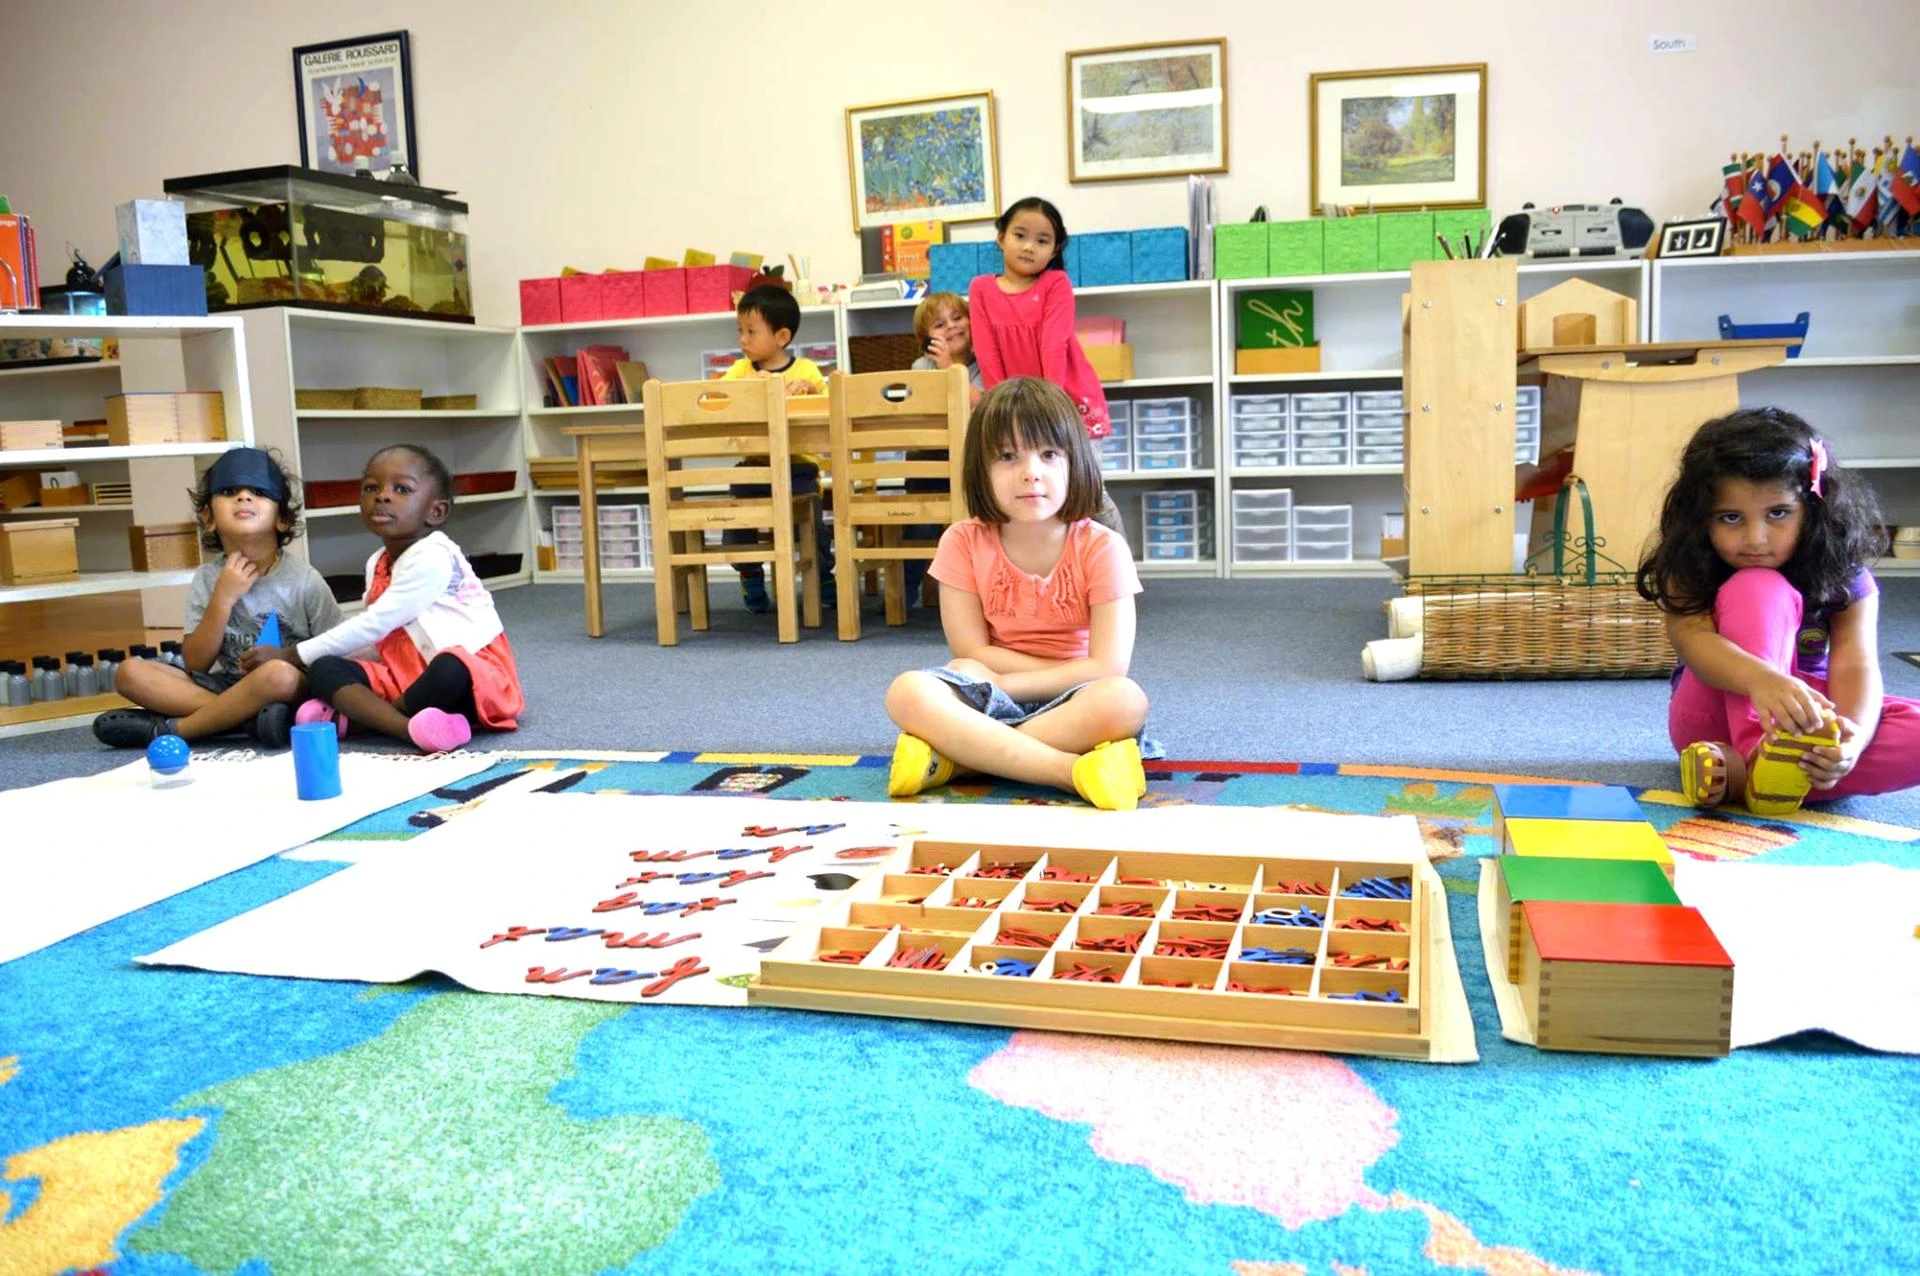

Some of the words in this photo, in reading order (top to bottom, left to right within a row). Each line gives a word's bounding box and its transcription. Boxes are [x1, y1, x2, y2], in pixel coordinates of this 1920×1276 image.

[304, 51, 343, 66] GALERIE
[346, 43, 398, 60] ROUSSARD
[1653, 38, 1686, 50] South
[524, 955, 710, 998] fan
